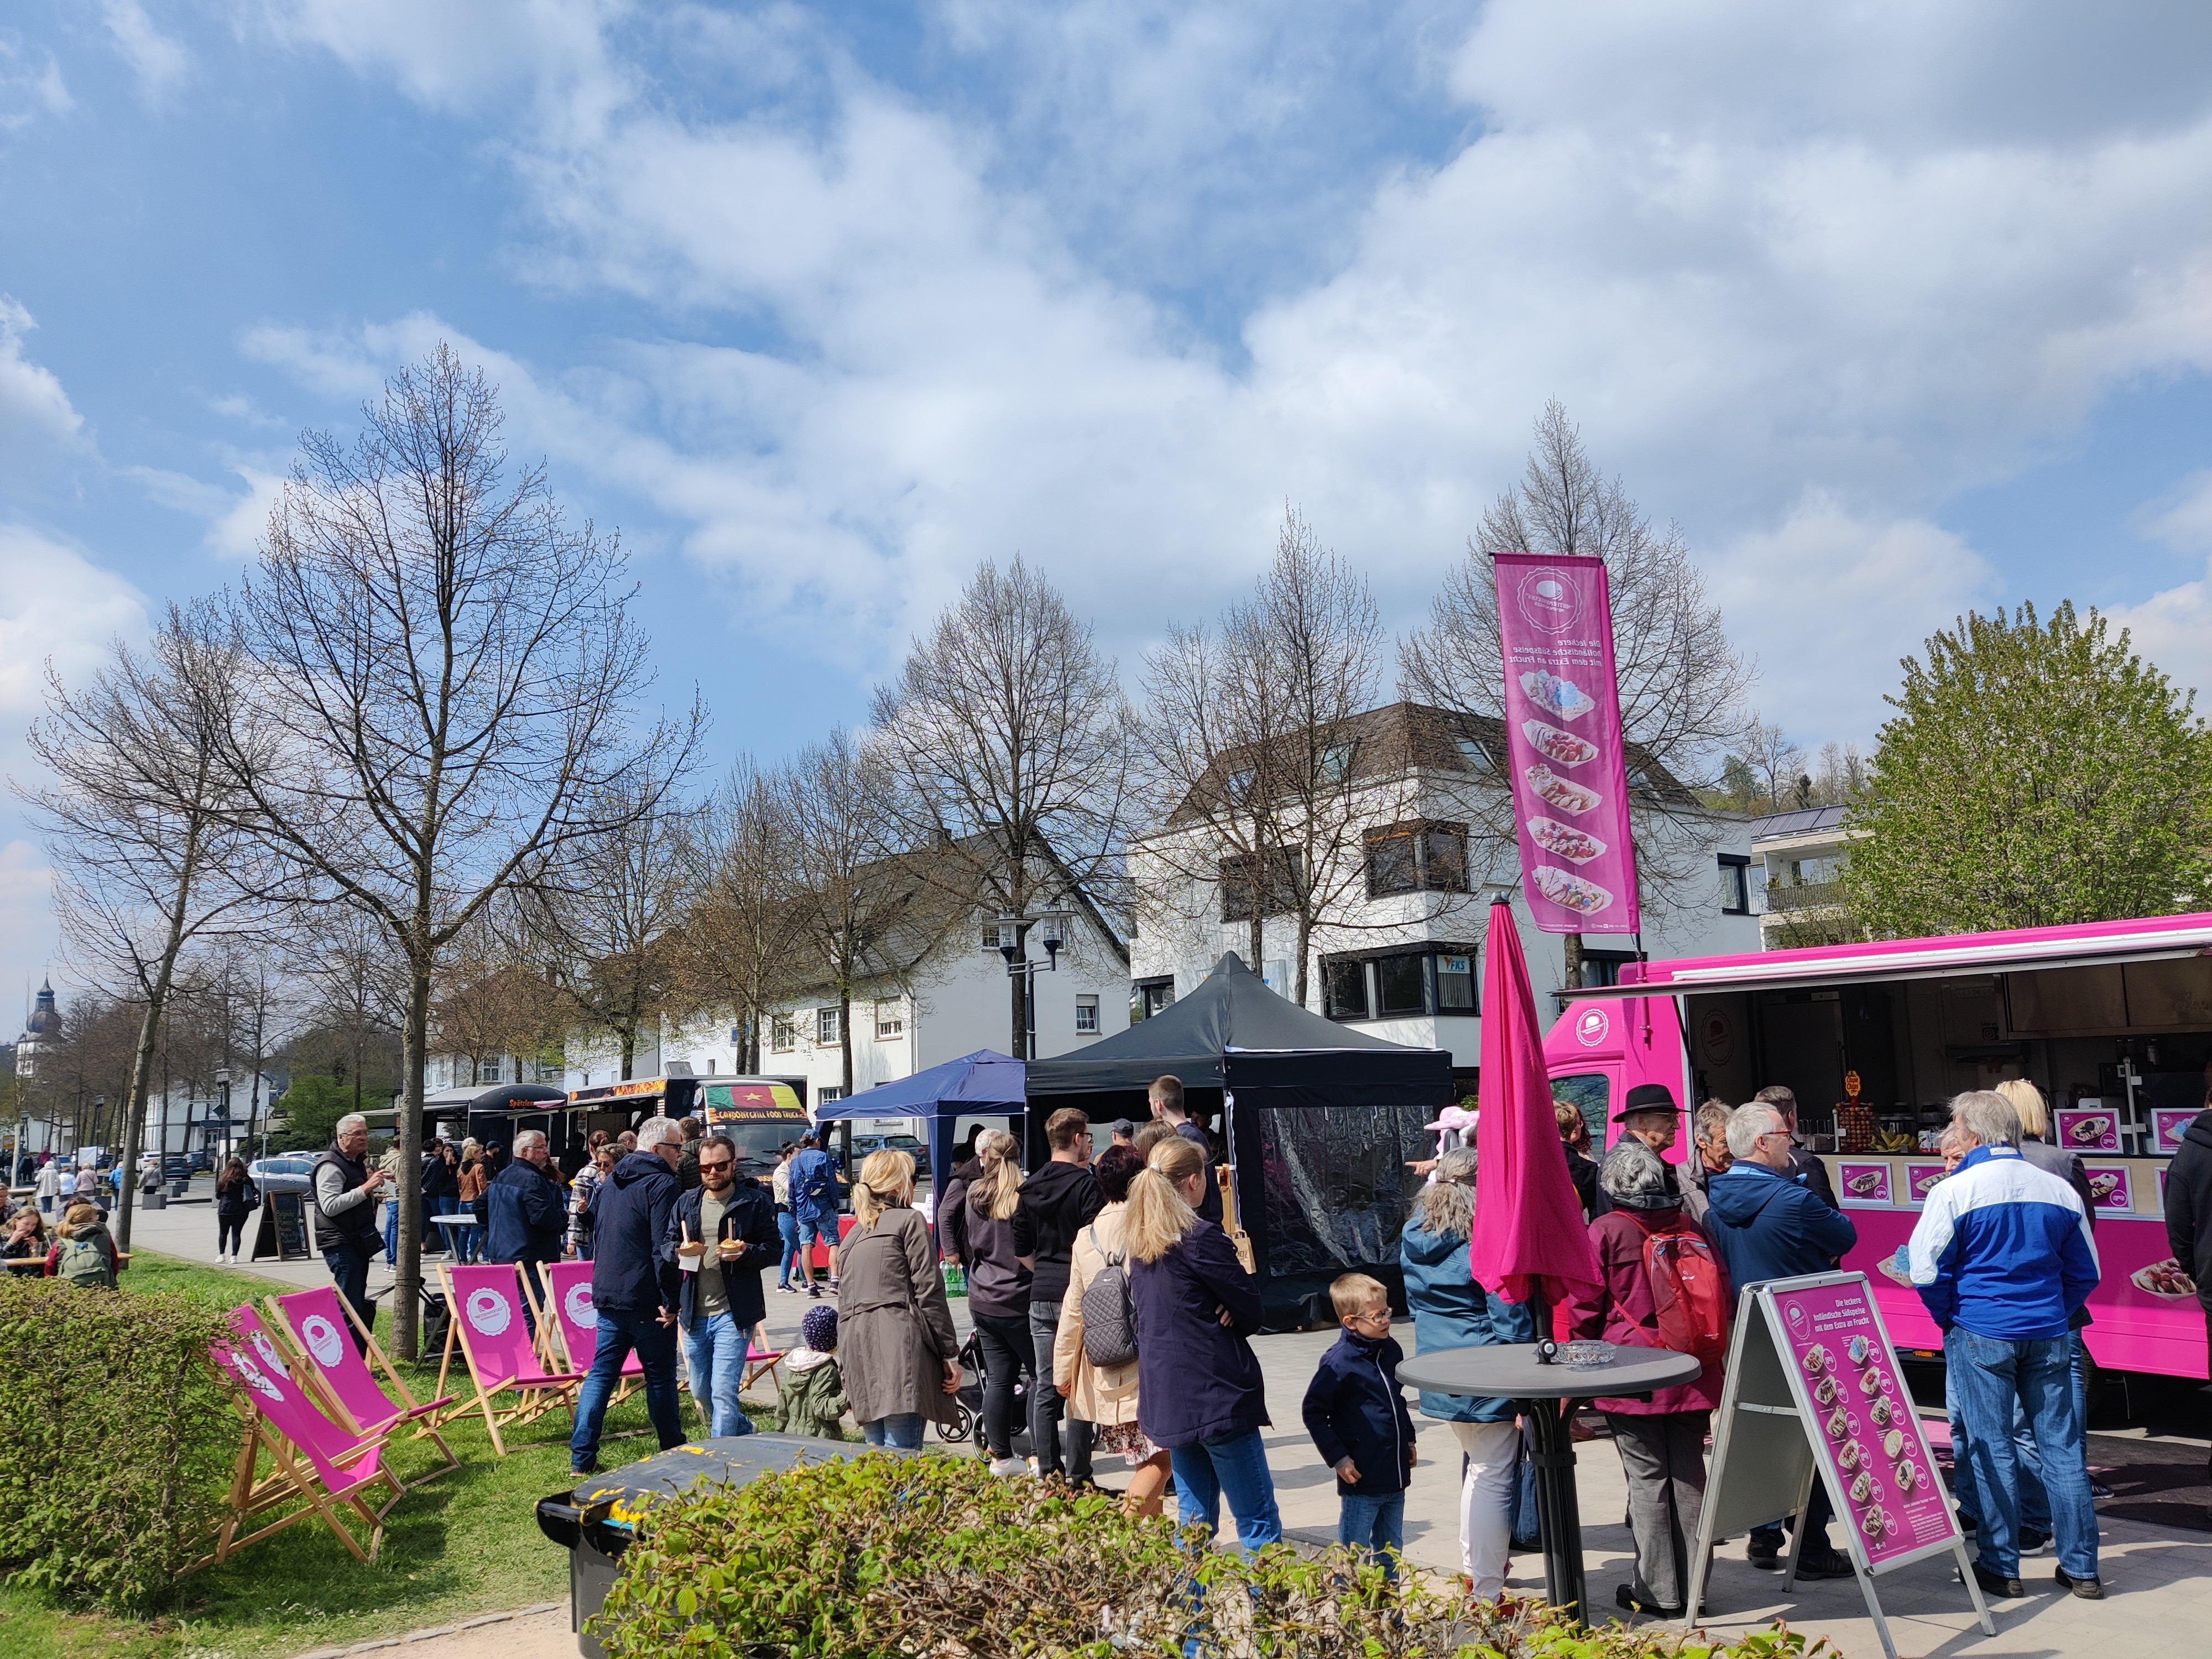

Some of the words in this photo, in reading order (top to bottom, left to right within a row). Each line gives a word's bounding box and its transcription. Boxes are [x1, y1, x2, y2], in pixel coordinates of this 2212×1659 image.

[1450, 960, 1465, 970] FKS
[1813, 1311, 1842, 1321] holländische
[1842, 1307, 1866, 1317] Süßspeise
[1853, 1317, 1870, 1326] Frucht
